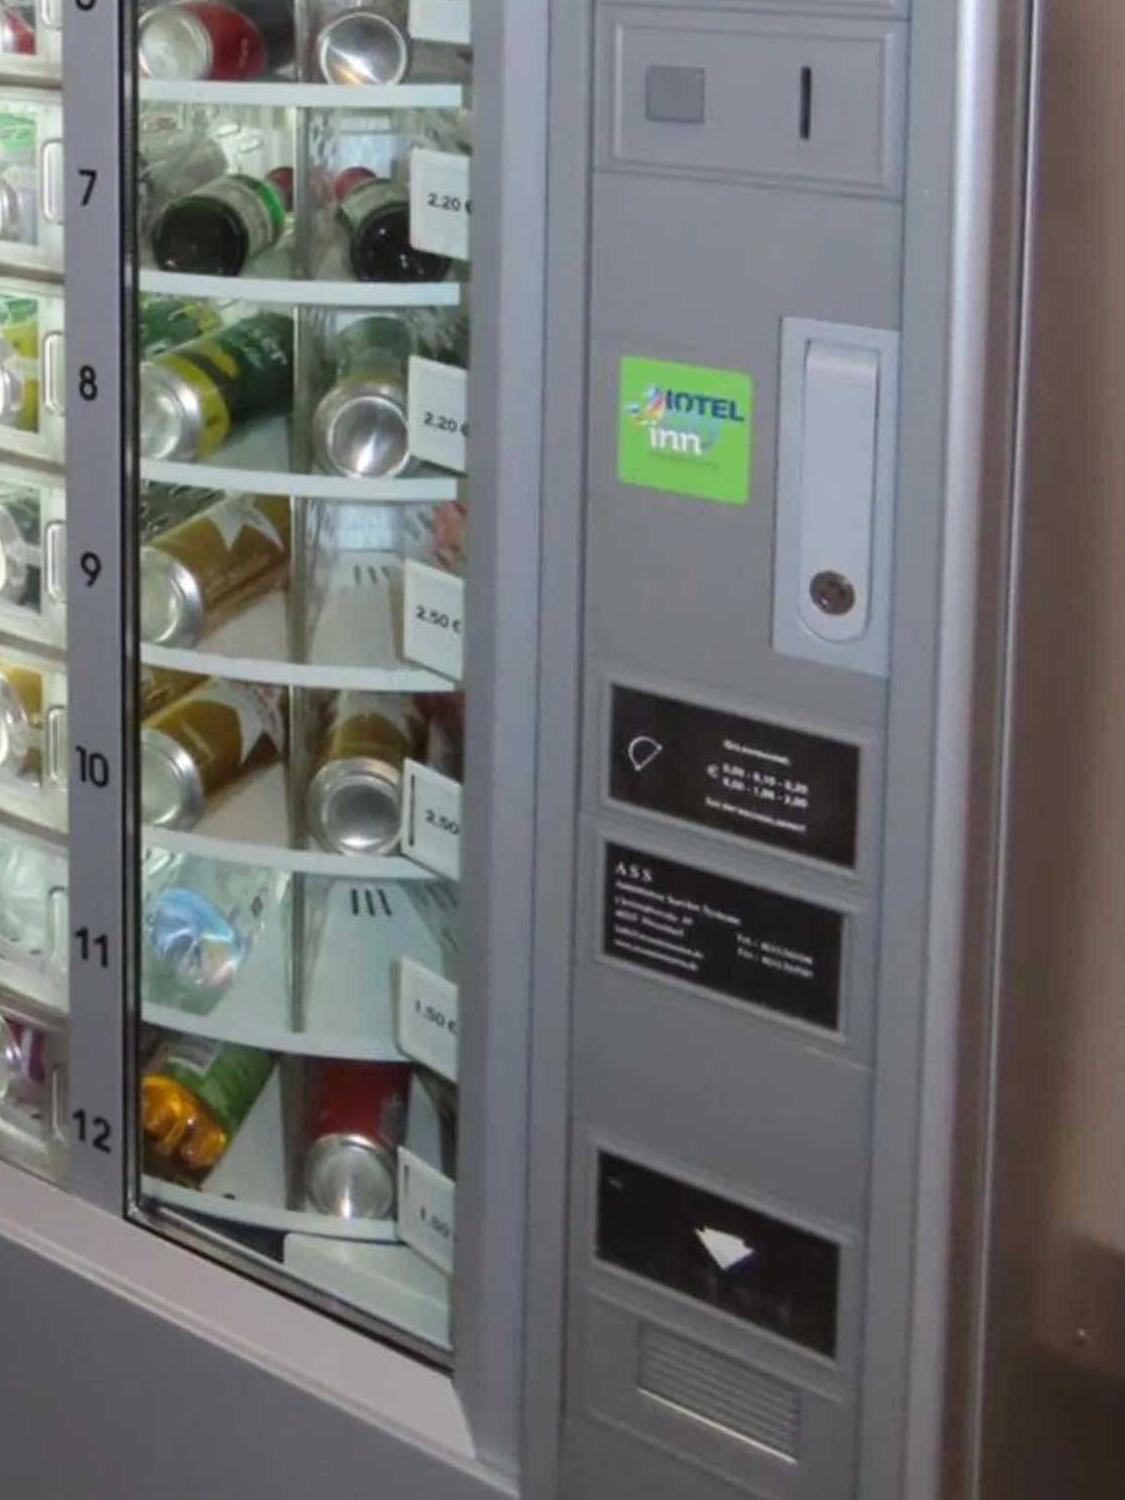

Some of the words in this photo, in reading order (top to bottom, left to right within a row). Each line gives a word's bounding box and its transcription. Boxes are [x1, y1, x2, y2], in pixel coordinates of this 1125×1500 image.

[77, 168, 98, 206] 7
[427, 192, 461, 212] 2.20
[78, 364, 98, 401] 8
[423, 412, 457, 434] 2.20
[648, 419, 703, 456] inn
[80, 551, 102, 588] 9
[415, 604, 450, 629] 2.50
[75, 745, 110, 788] 10
[74, 926, 110, 970] 11
[72, 1108, 112, 1155] 12
